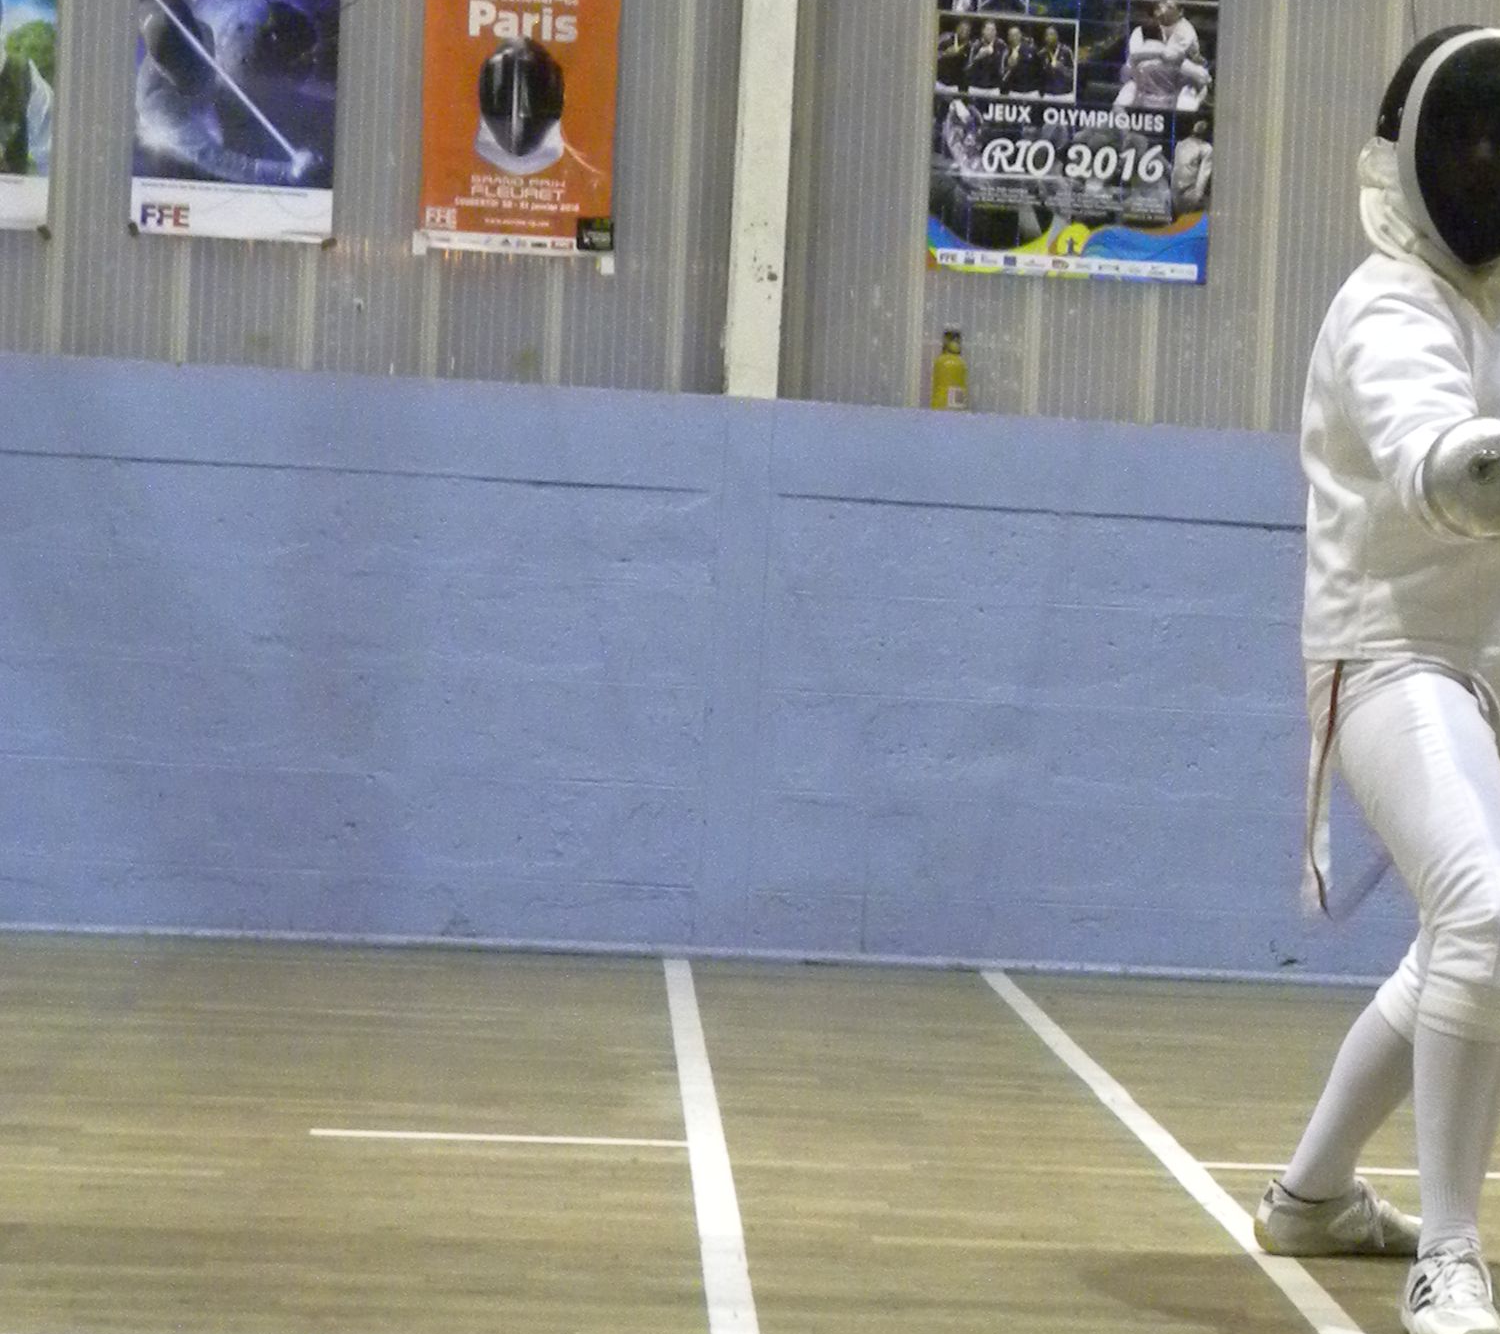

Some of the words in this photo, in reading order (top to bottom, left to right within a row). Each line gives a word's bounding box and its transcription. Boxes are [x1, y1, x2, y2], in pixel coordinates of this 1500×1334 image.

[468, 0, 579, 42] Paris
[983, 103, 1031, 124] JEUX
[1043, 107, 1165, 132] OLYMPIQUES
[982, 138, 1056, 178] RIO
[1065, 143, 1165, 182] 2016
[140, 202, 190, 228] FFE
